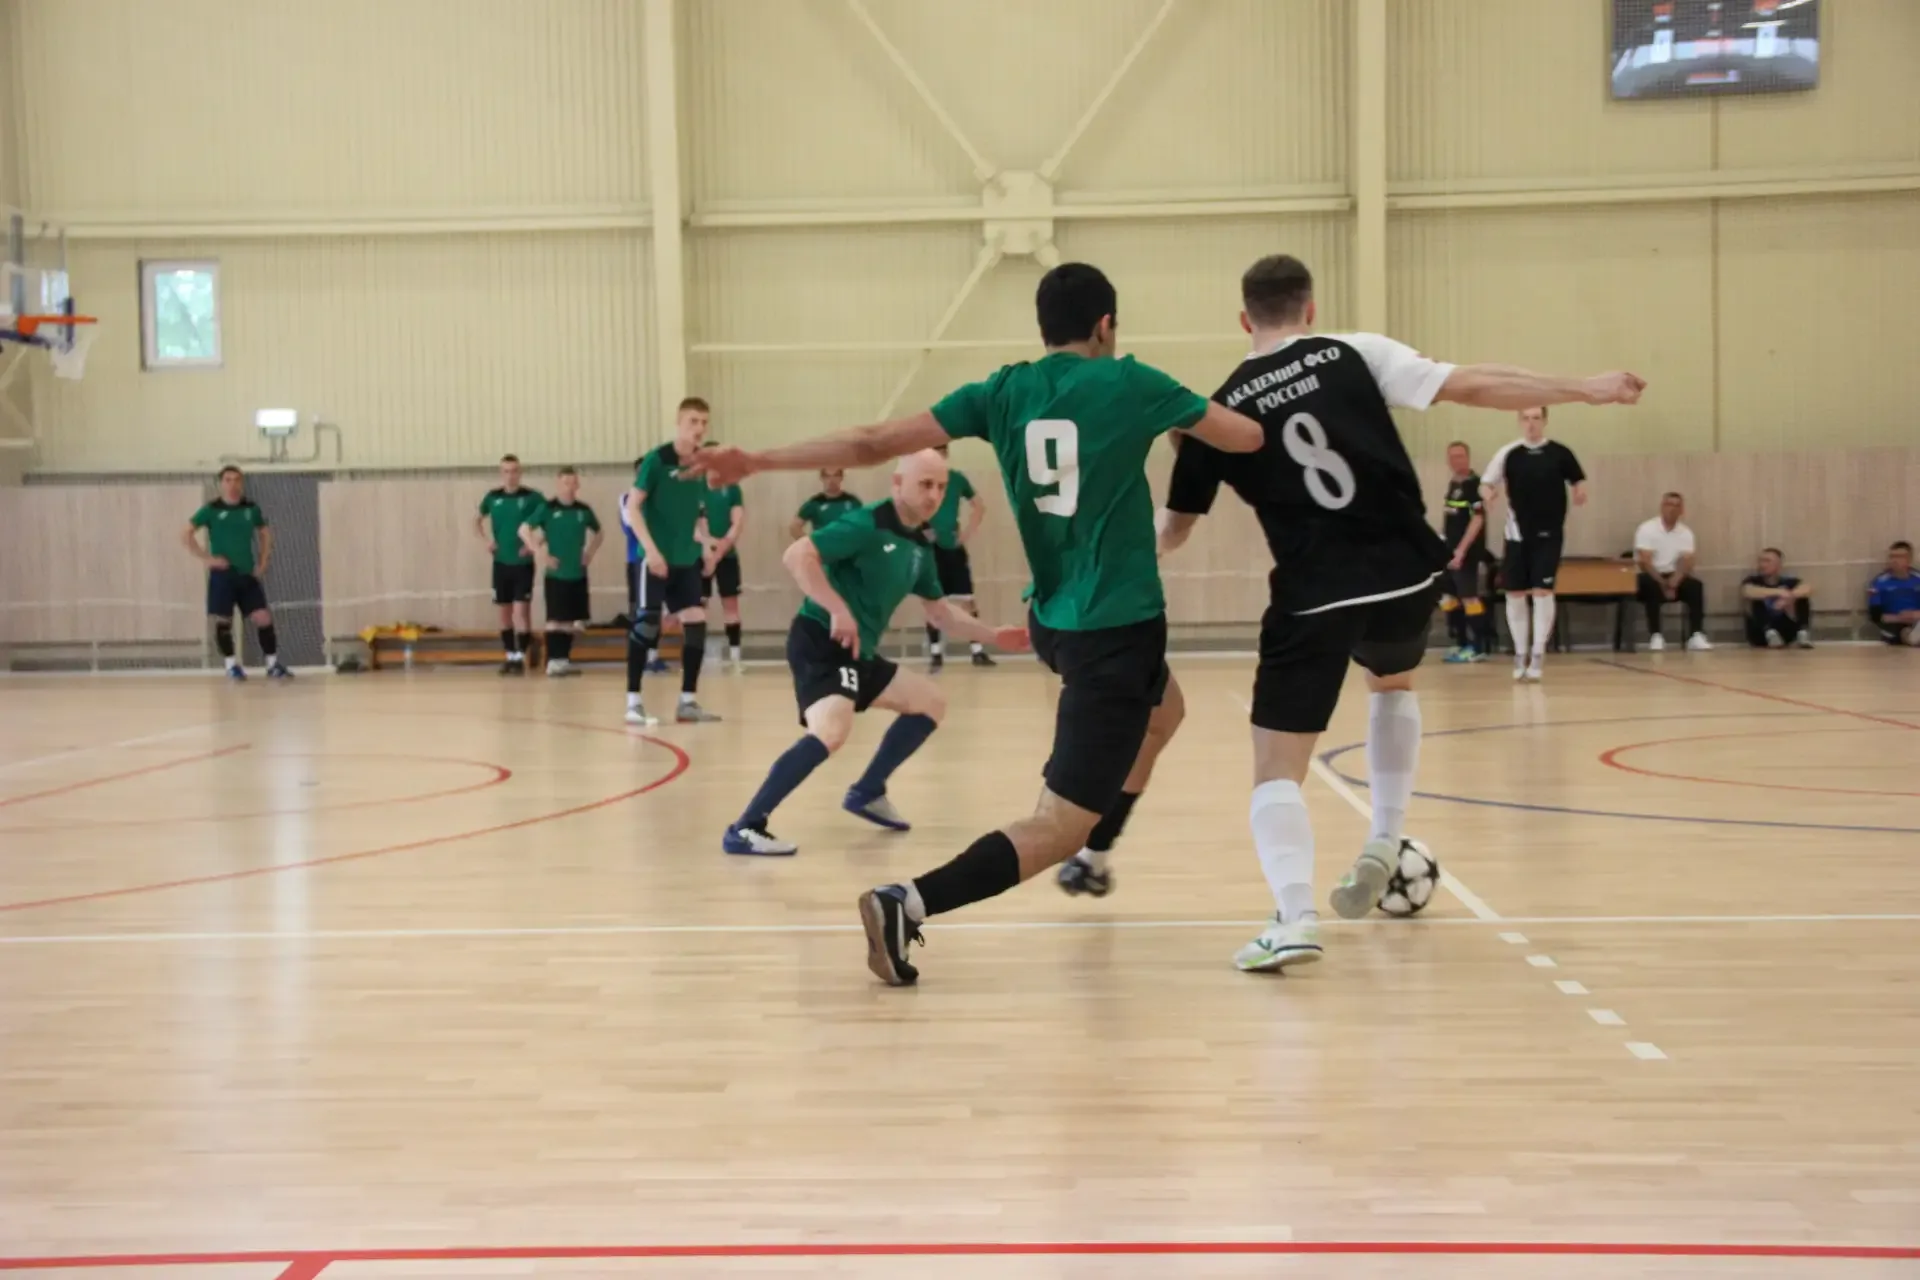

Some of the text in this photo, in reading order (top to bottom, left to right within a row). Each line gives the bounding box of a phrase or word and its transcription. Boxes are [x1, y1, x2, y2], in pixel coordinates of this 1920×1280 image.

[1303, 346, 1341, 367] ФСО
[1255, 374, 1320, 415] РОССИИ
[1025, 418, 1079, 517] 9
[1282, 411, 1356, 510] 8
[839, 666, 859, 692] 13
